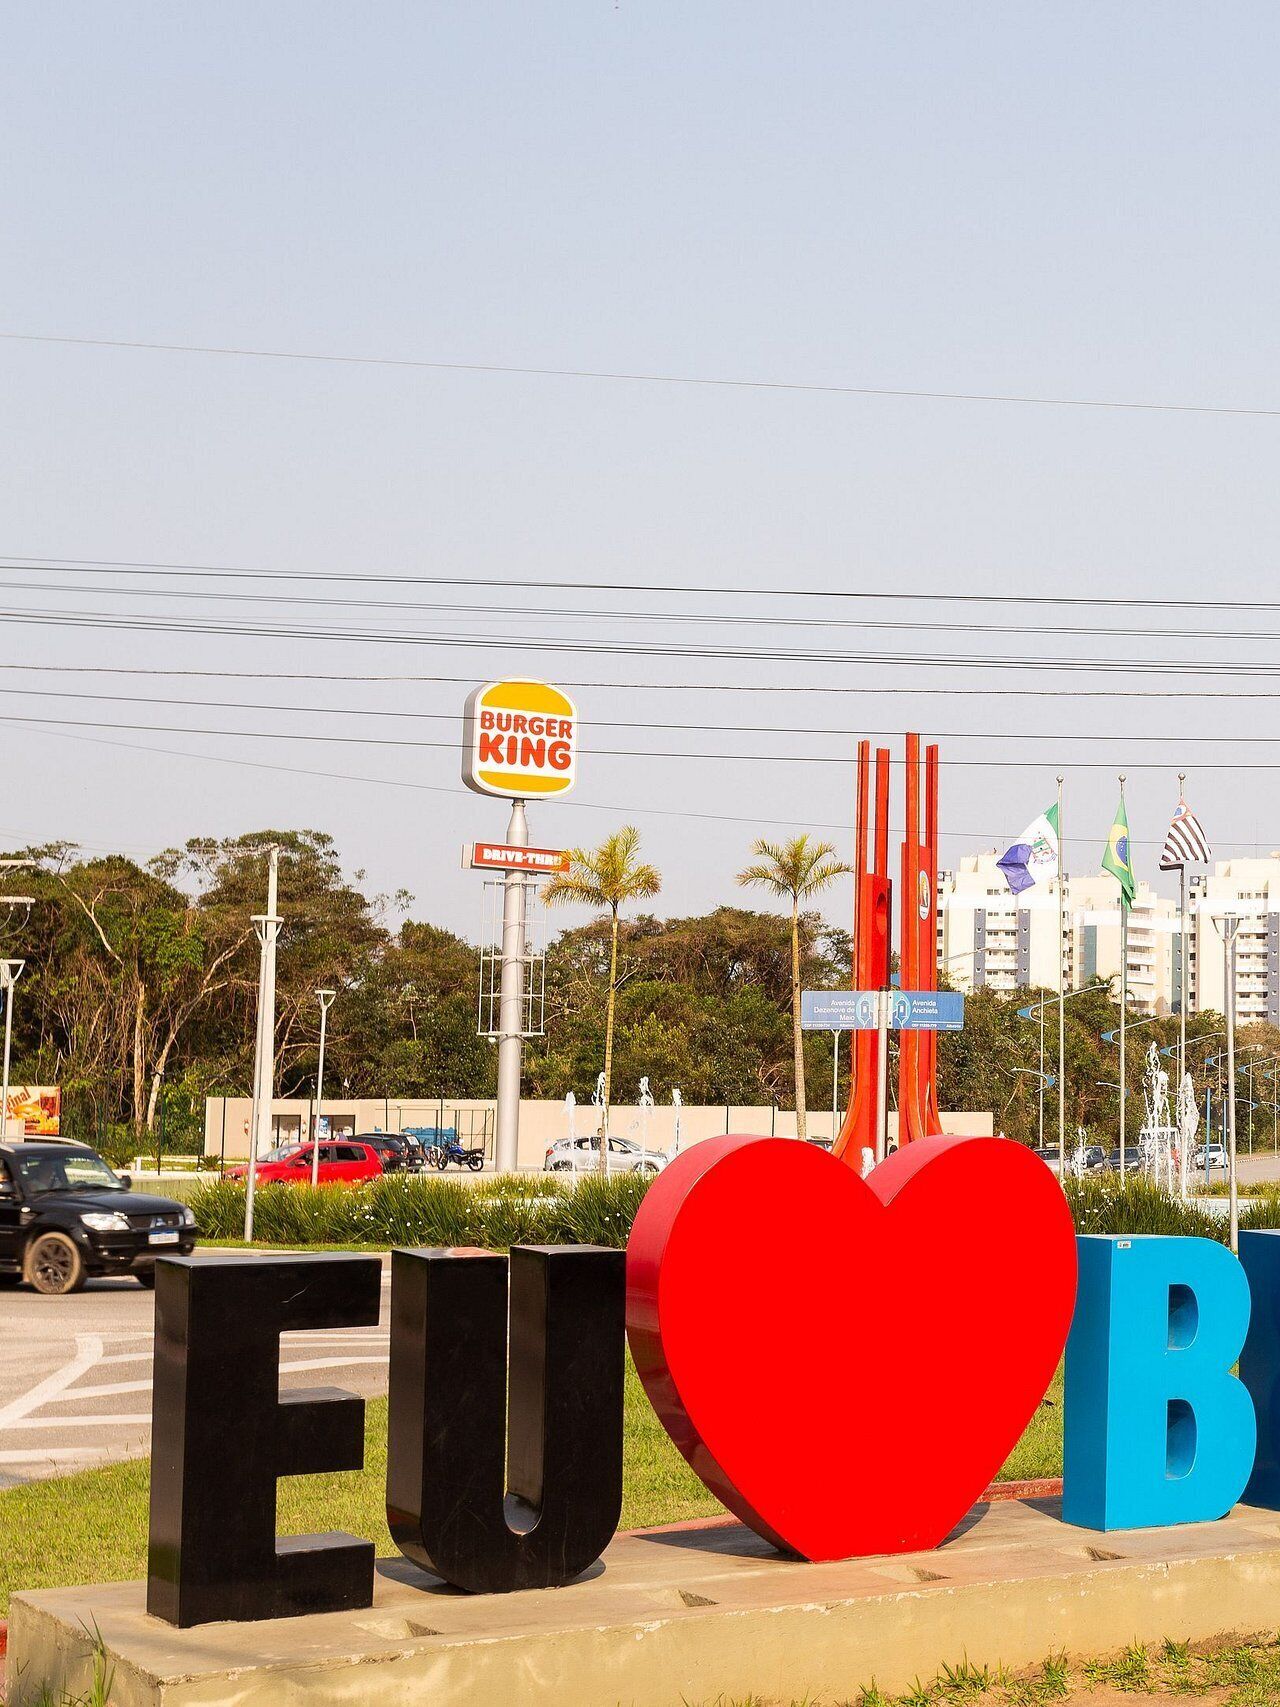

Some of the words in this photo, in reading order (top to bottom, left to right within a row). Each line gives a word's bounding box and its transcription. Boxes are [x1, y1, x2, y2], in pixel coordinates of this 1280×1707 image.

[480, 711, 573, 740] BURGER
[479, 732, 572, 771] KING
[482, 848, 563, 866] DRIVE-THRU
[147, 1244, 627, 1628] EU
